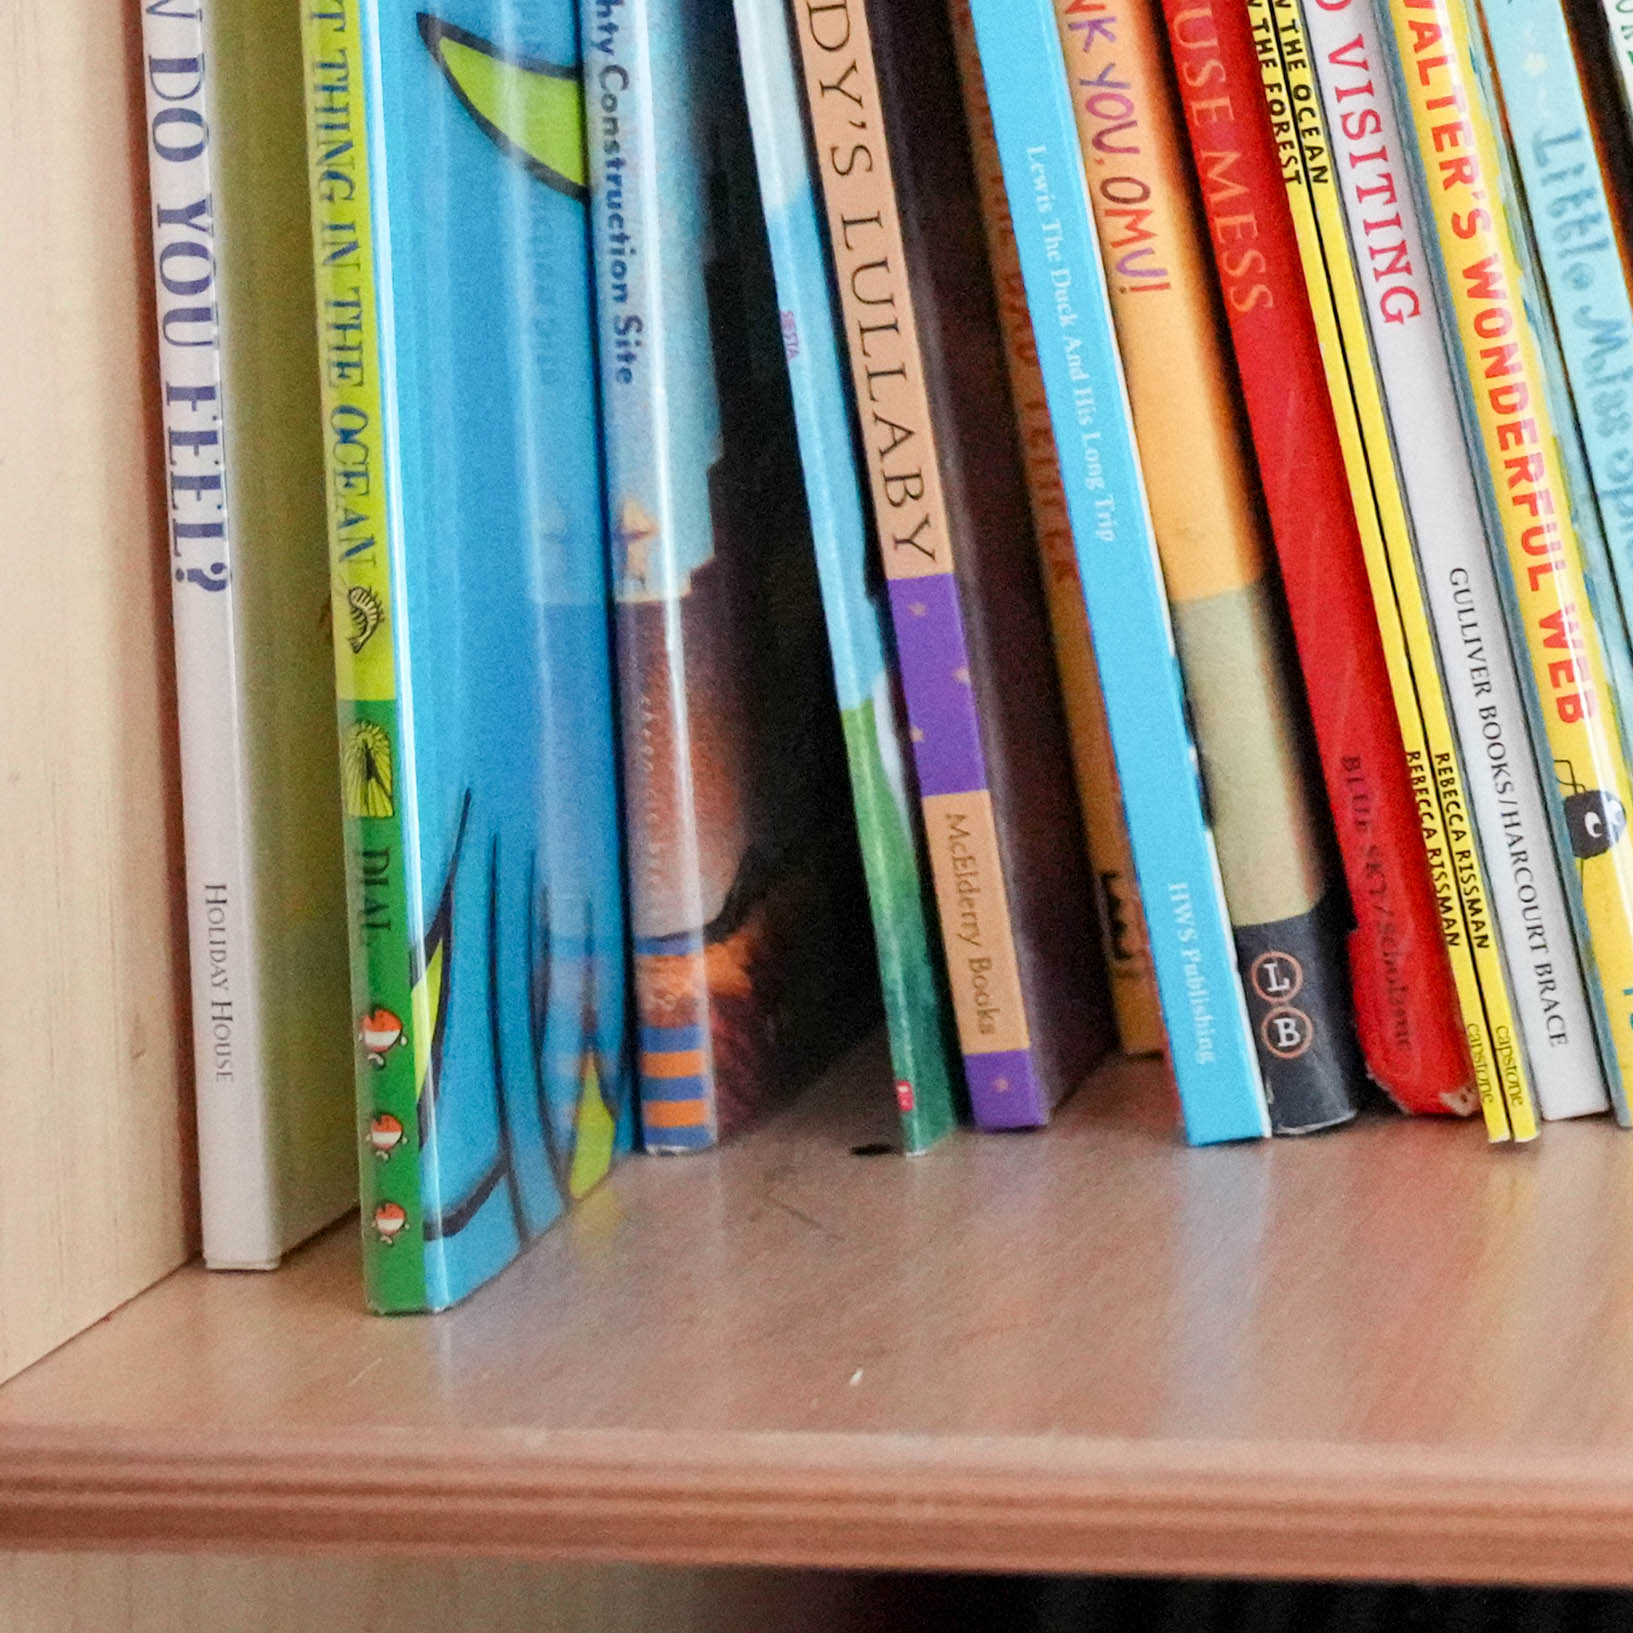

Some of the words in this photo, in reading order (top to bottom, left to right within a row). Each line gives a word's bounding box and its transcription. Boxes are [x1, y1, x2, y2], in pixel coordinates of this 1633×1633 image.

[146, 53, 209, 163] DO
[307, 46, 359, 208] THING
[1077, 60, 1142, 165] YOU,
[1275, 12, 1305, 72] THE
[1290, 82, 1328, 187] OCEAN
[594, 62, 643, 306] Construction
[1022, 143, 1056, 215] Lewis
[1036, 218, 1067, 267] The
[1096, 170, 1169, 300] OMU!
[1200, 141, 1275, 317] MESS
[1323, 35, 1423, 329] VISITING
[1524, 118, 1617, 294] Little
[149, 197, 219, 349] YOU
[316, 219, 356, 275] IN
[1046, 264, 1080, 333] Duck
[320, 287, 364, 391] THE
[607, 314, 645, 385] Site
[838, 208, 938, 566] LULLABY
[1060, 333, 1091, 384] And
[1070, 386, 1099, 425] His
[1073, 430, 1112, 492] Long
[161, 380, 235, 593] FEEL?
[326, 404, 376, 567] OCEAN
[1086, 493, 1122, 544] Trip
[1459, 252, 1569, 596] WONDERFUL
[1534, 604, 1599, 728] WEB
[1432, 750, 1467, 843] REBECCA
[1453, 845, 1491, 950] RISSMAN
[1445, 564, 1494, 698] GULLIVER
[1474, 700, 1549, 958] BOOKS/HARCOURT
[1529, 960, 1569, 1047] BRACE
[938, 810, 989, 950] McElderry
[962, 954, 1004, 1038] Books
[1490, 1022, 1526, 1107] capstone
